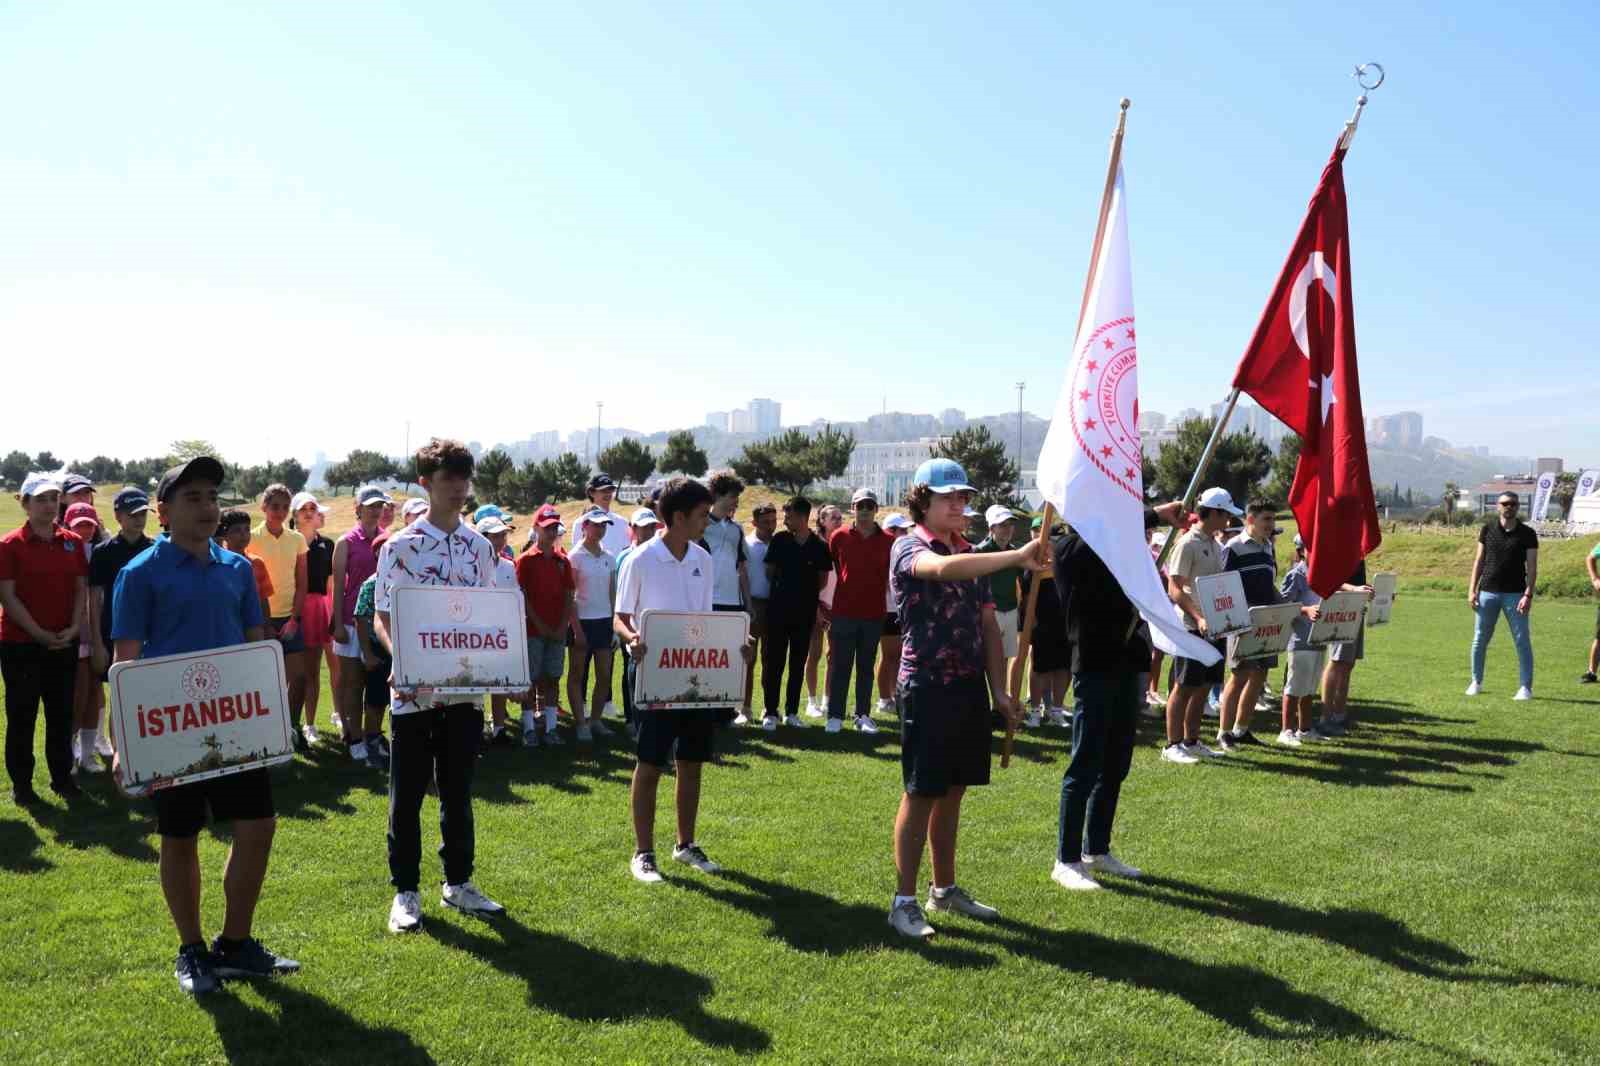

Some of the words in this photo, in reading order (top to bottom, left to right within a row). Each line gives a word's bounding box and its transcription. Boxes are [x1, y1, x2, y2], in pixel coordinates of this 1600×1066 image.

[1324, 610, 1358, 624] ANTALYA
[418, 627, 509, 650] TEKİRDAĞ
[658, 647, 730, 669] ANKARA
[137, 689, 270, 739] İSTANBUL
